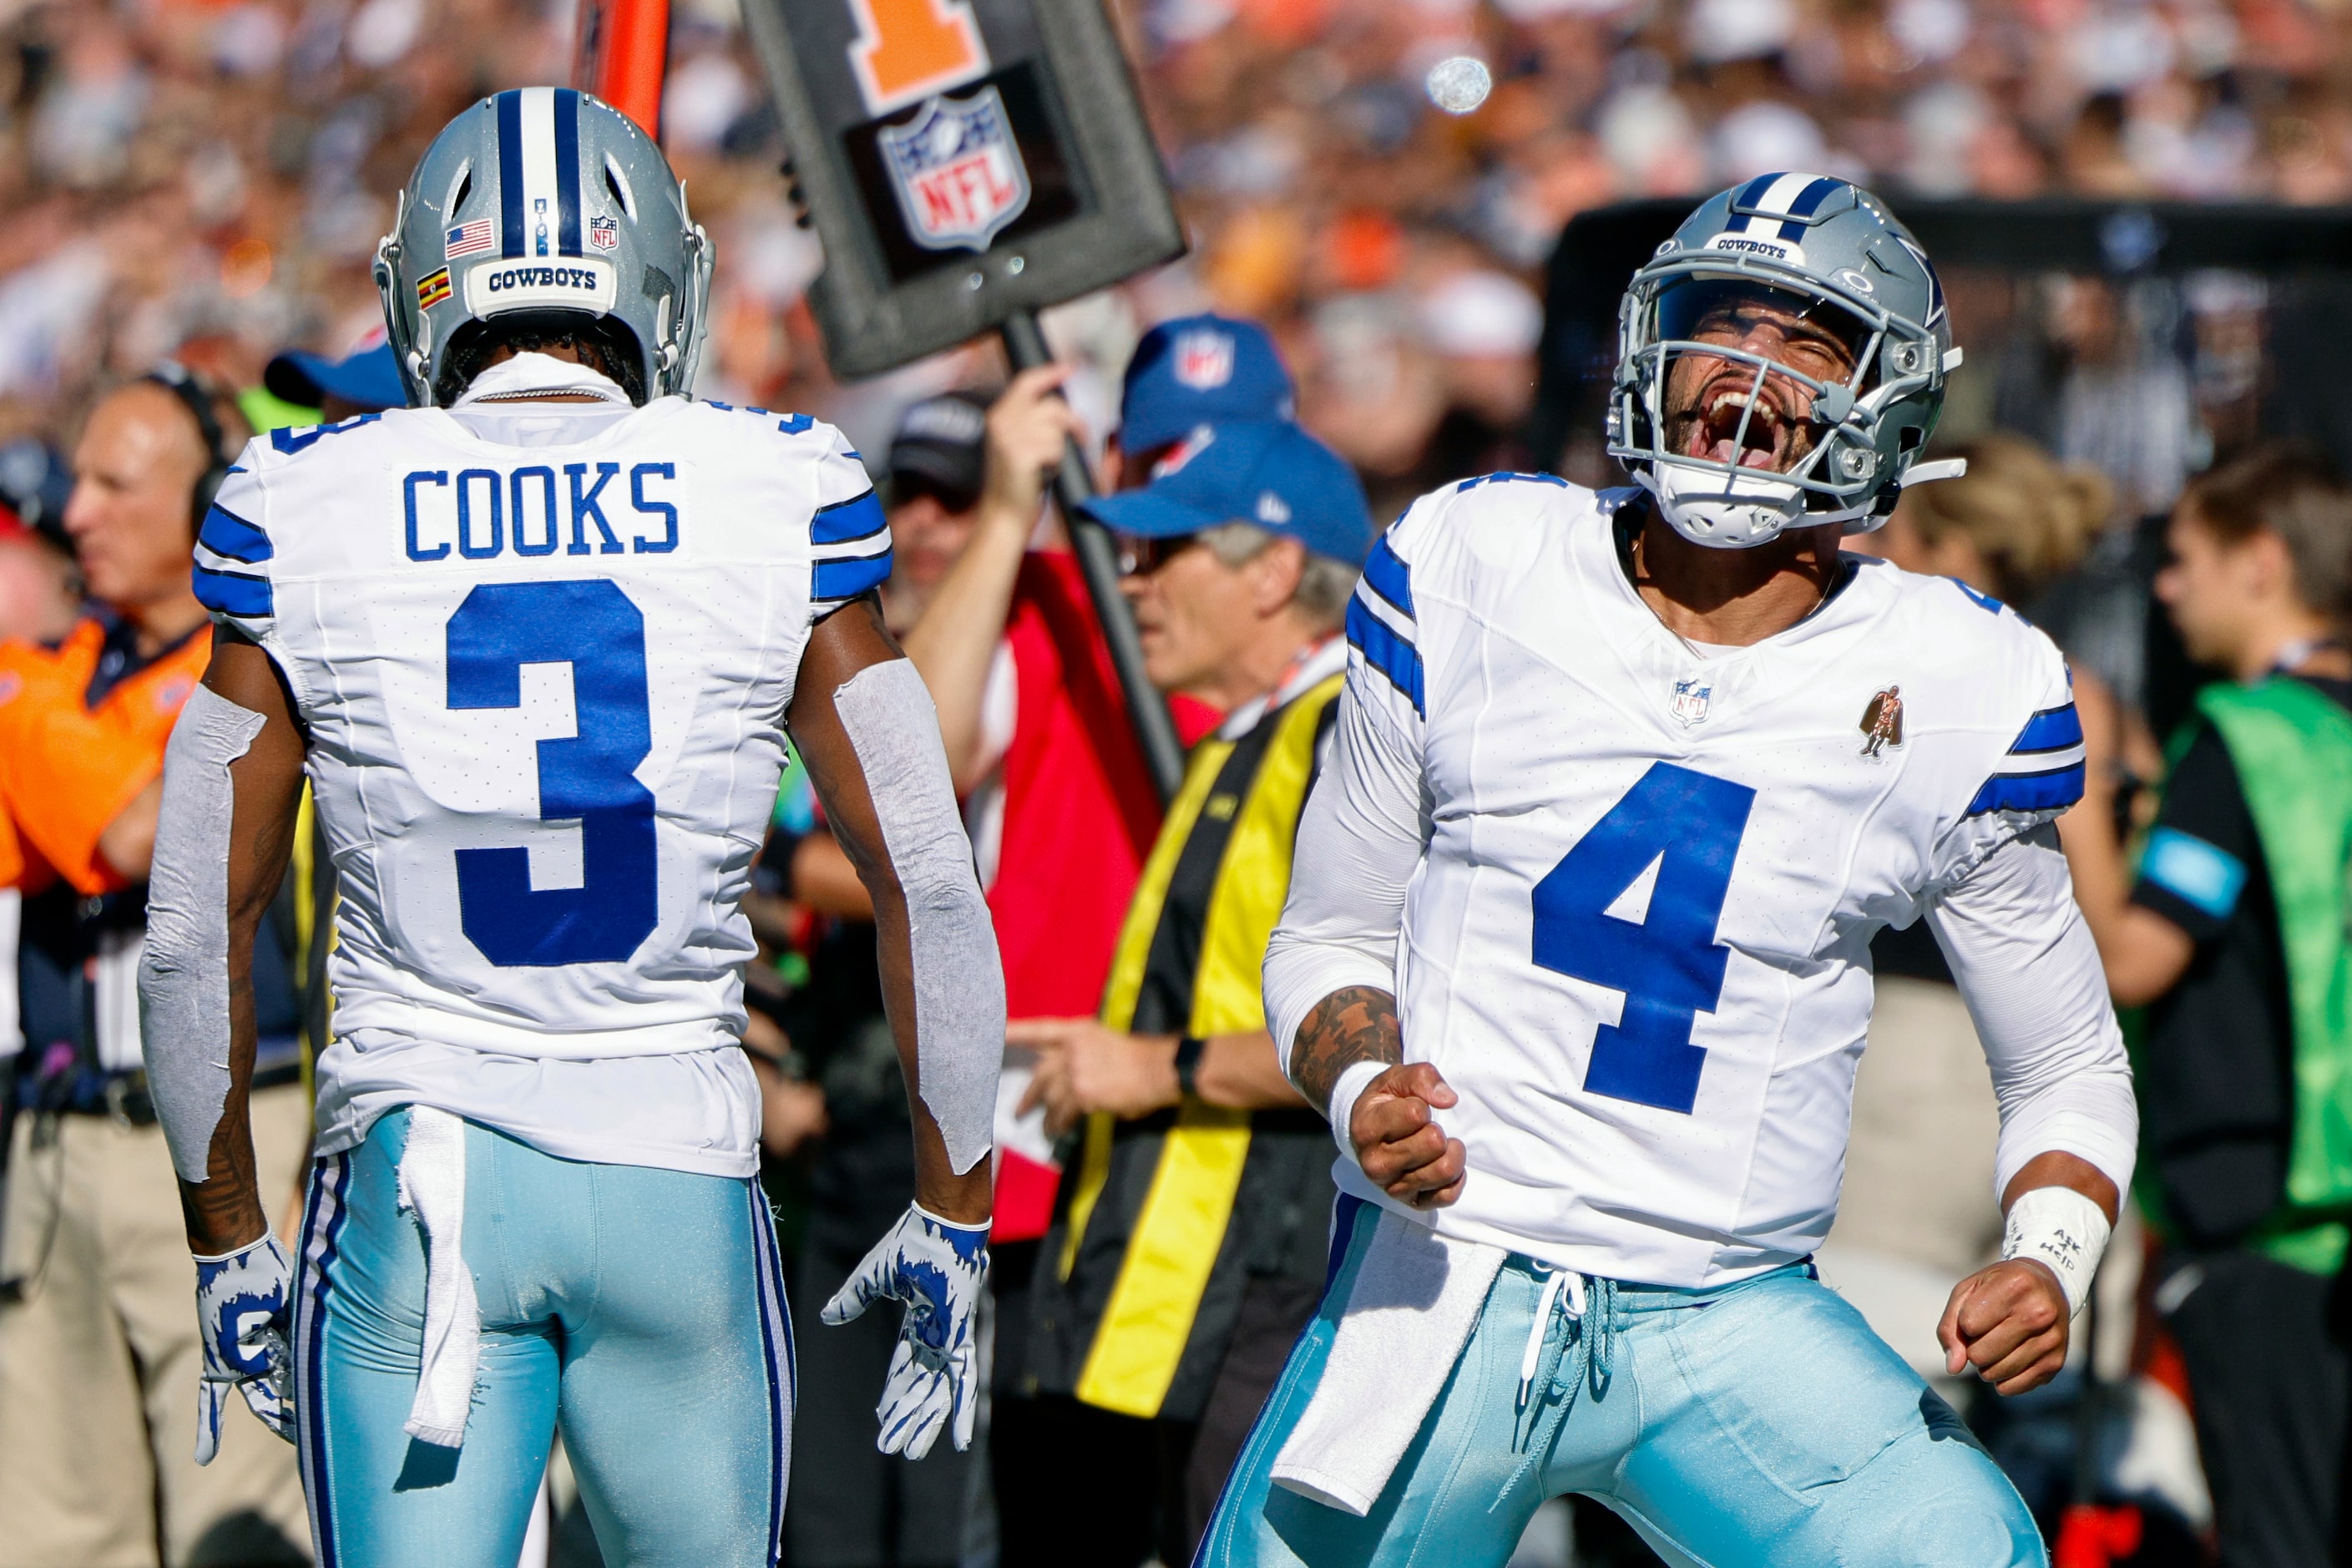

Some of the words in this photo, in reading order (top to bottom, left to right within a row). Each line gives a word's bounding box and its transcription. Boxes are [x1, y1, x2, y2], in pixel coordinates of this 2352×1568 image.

[918, 157, 1014, 231] NFL
[594, 230, 615, 246] NFL
[1717, 240, 1787, 259] COWBOYS
[489, 267, 596, 292] COWBOYS
[403, 462, 679, 562] COOKS
[1677, 697, 1703, 716] NFL
[446, 578, 658, 968] 3
[1531, 761, 1757, 1115] 4
